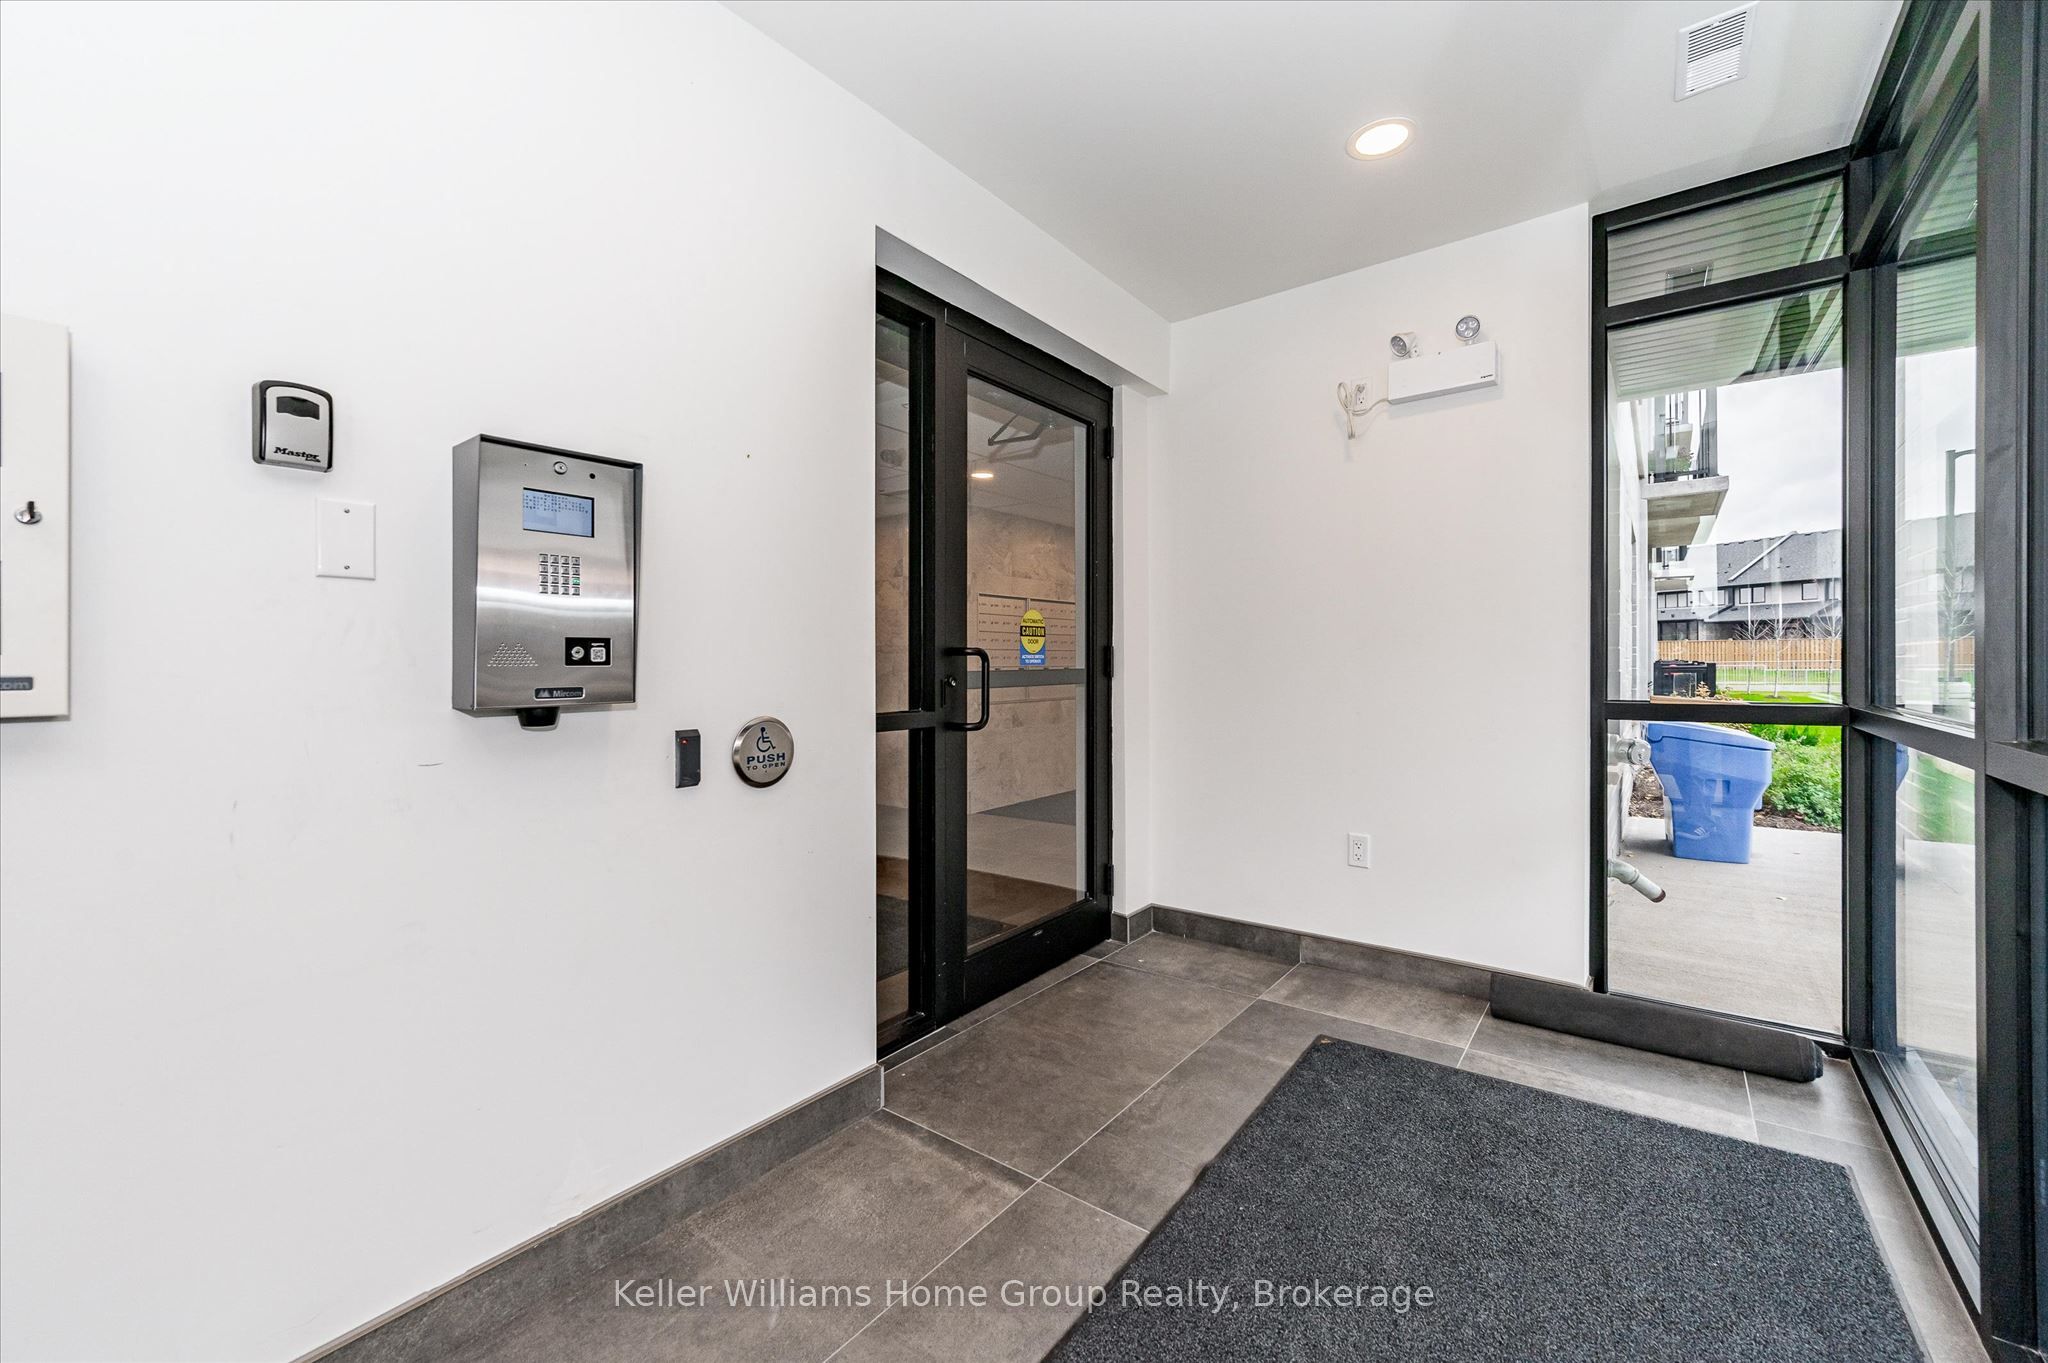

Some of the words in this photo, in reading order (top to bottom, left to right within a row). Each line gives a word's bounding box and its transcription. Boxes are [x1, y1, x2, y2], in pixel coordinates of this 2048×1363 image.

[273, 446, 320, 459] Master
[1022, 626, 1045, 635] CAUTION
[552, 690, 582, 698] Mircom
[747, 752, 785, 764] PUSH
